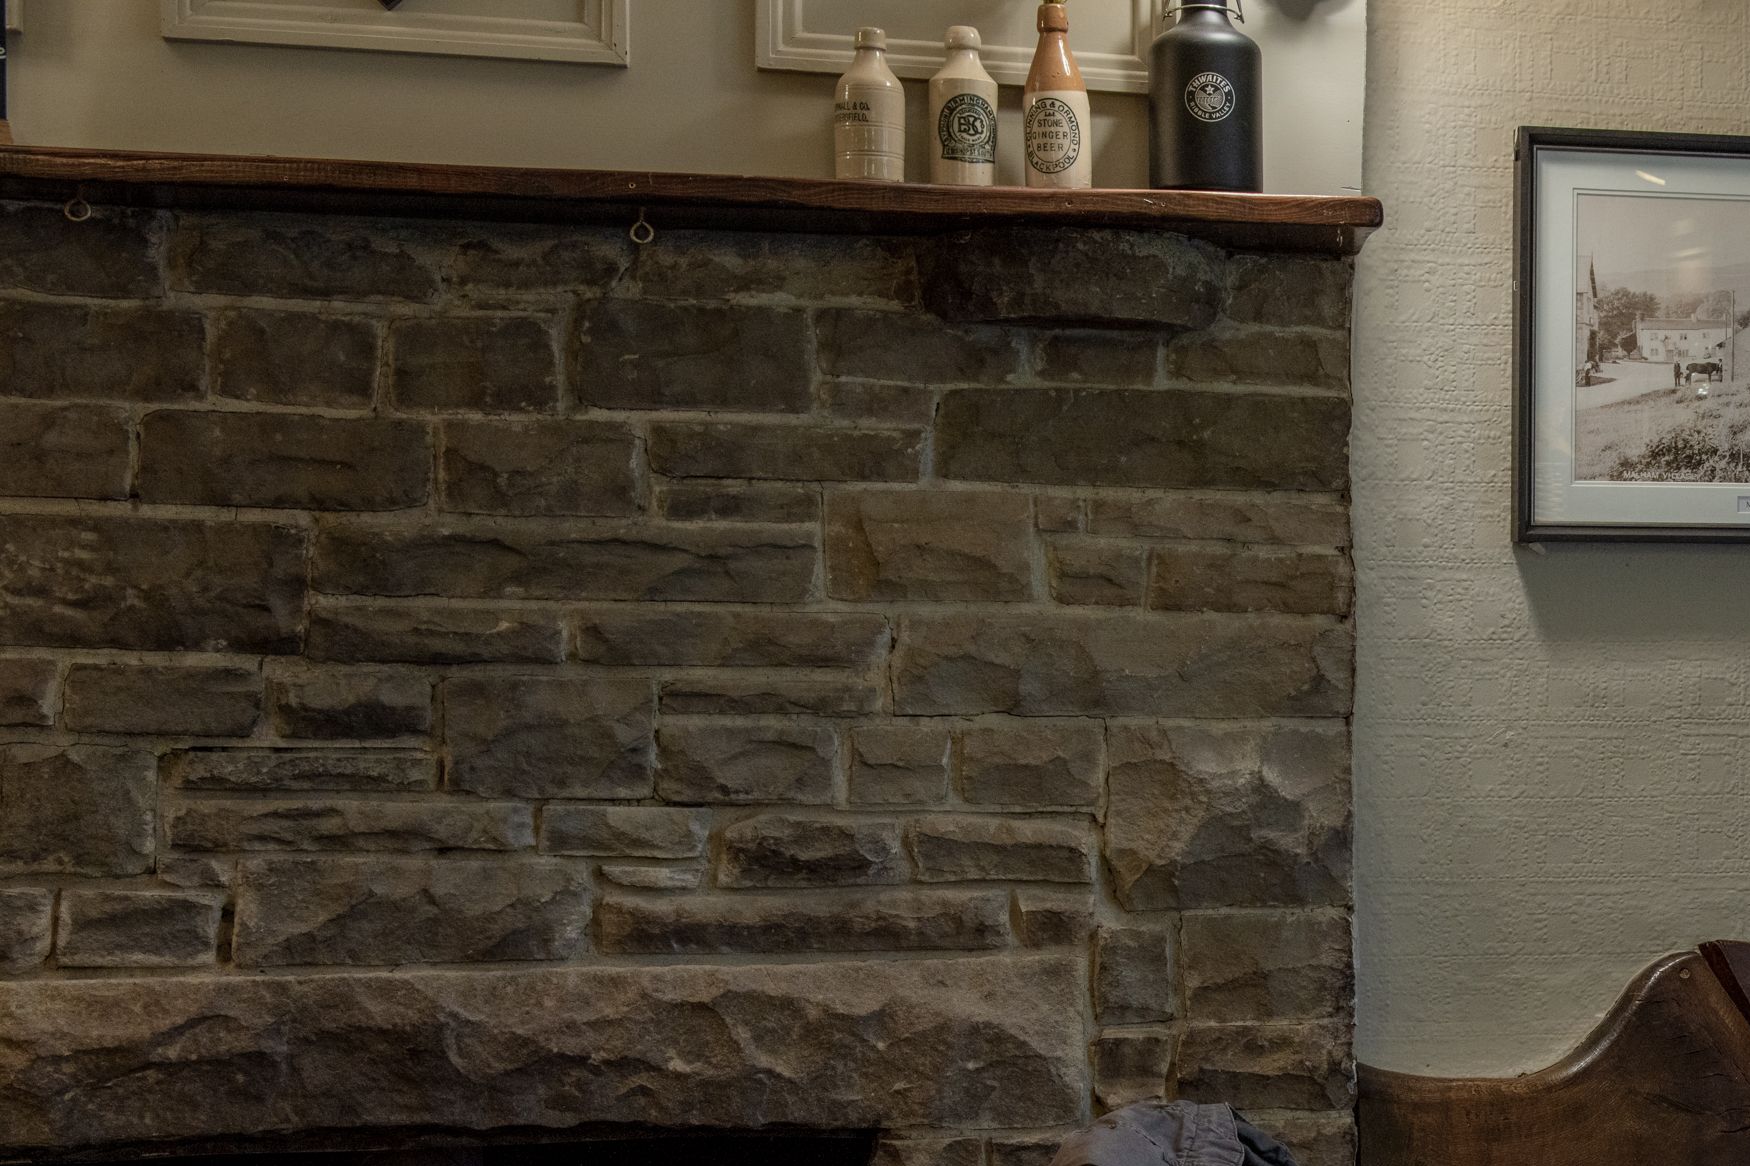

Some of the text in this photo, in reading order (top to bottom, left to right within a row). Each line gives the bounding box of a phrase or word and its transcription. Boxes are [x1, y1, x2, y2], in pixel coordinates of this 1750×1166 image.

[1189, 74, 1231, 92] THWAITES
[852, 102, 858, 110] &
[1211, 101, 1231, 119] VALLEY
[1037, 118, 1064, 128] STONE
[1058, 104, 1079, 146] ORMOND
[1032, 130, 1069, 140] GINGER
[1036, 142, 1064, 152] BEER
[1028, 150, 1075, 172] BLACKPOOL
